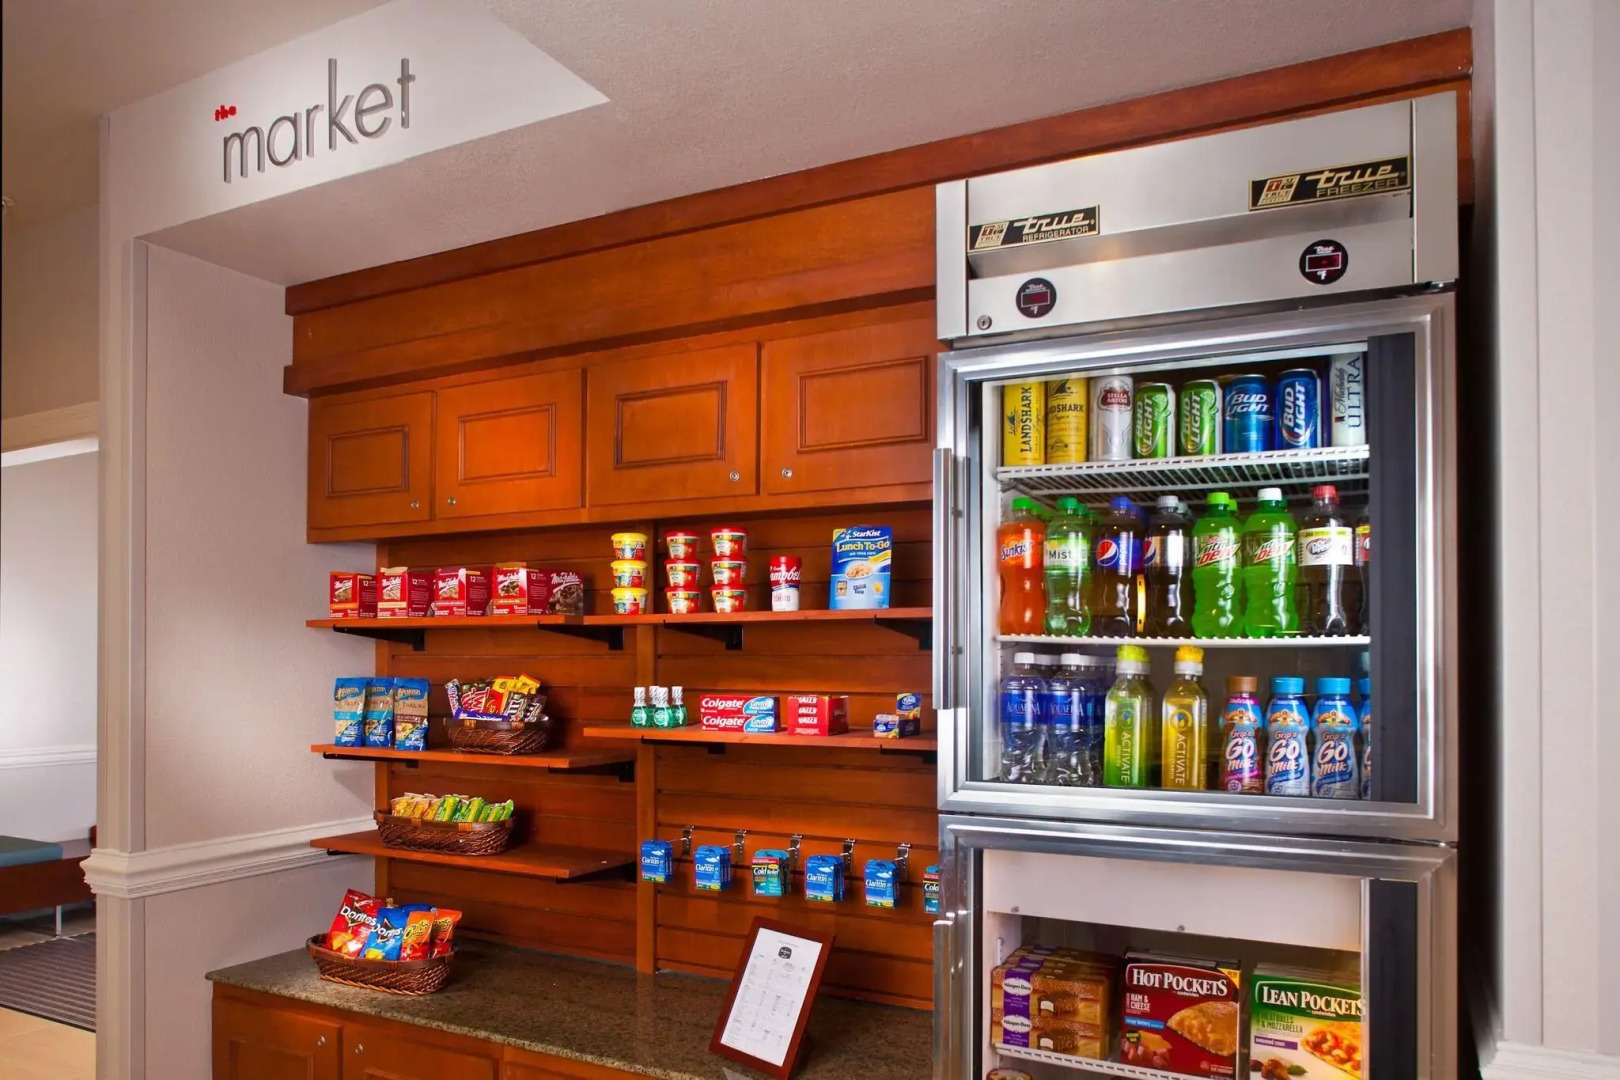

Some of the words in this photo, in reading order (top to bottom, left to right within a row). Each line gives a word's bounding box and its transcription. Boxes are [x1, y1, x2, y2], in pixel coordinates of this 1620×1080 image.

[215, 105, 237, 121] the
[223, 58, 416, 183] market
[1305, 164, 1399, 188] true
[1316, 178, 1399, 198] FREEZER
[1013, 211, 1090, 234] true
[1022, 226, 1089, 243] REFRIGERATOR
[1107, 392, 1128, 400] STELLA
[1231, 392, 1268, 405] BUD
[1347, 355, 1362, 428] ULTRA
[1182, 397, 1191, 434] BUD
[1226, 403, 1270, 415] LIGHT
[1283, 386, 1295, 428] BUD
[1294, 381, 1307, 438] LIGHT
[1020, 386, 1032, 453] LANDSHARK
[1136, 401, 1144, 438] BUD
[1143, 394, 1154, 447] LIGHT
[1190, 391, 1202, 444] LIGHT
[852, 530, 881, 538] StarKist
[836, 541, 864, 553] Lunch
[864, 541, 890, 550] To-Go
[770, 566, 801, 584] ampbel
[701, 698, 744, 710] Colgate
[703, 715, 745, 727] Colgate
[1120, 731, 1131, 787] ACTIVATE
[1175, 733, 1186, 786] ACTIVATE
[641, 856, 660, 865] Claritin
[695, 864, 715, 873] Claritin
[753, 867, 767, 875] Cold
[806, 873, 828, 883] Claritin
[865, 879, 887, 889] Claritin
[340, 905, 377, 926] Doritos
[1132, 968, 1162, 988] HOT
[1163, 972, 1228, 996] POCKETS
[1130, 993, 1143, 1003] HAM
[1144, 995, 1149, 1003] &
[1130, 1001, 1151, 1012] CHEESE
[1263, 986, 1299, 1007] LEAN
[1300, 990, 1366, 1016] POCKETS
[1266, 1021, 1303, 1033] MOZZARELLA
